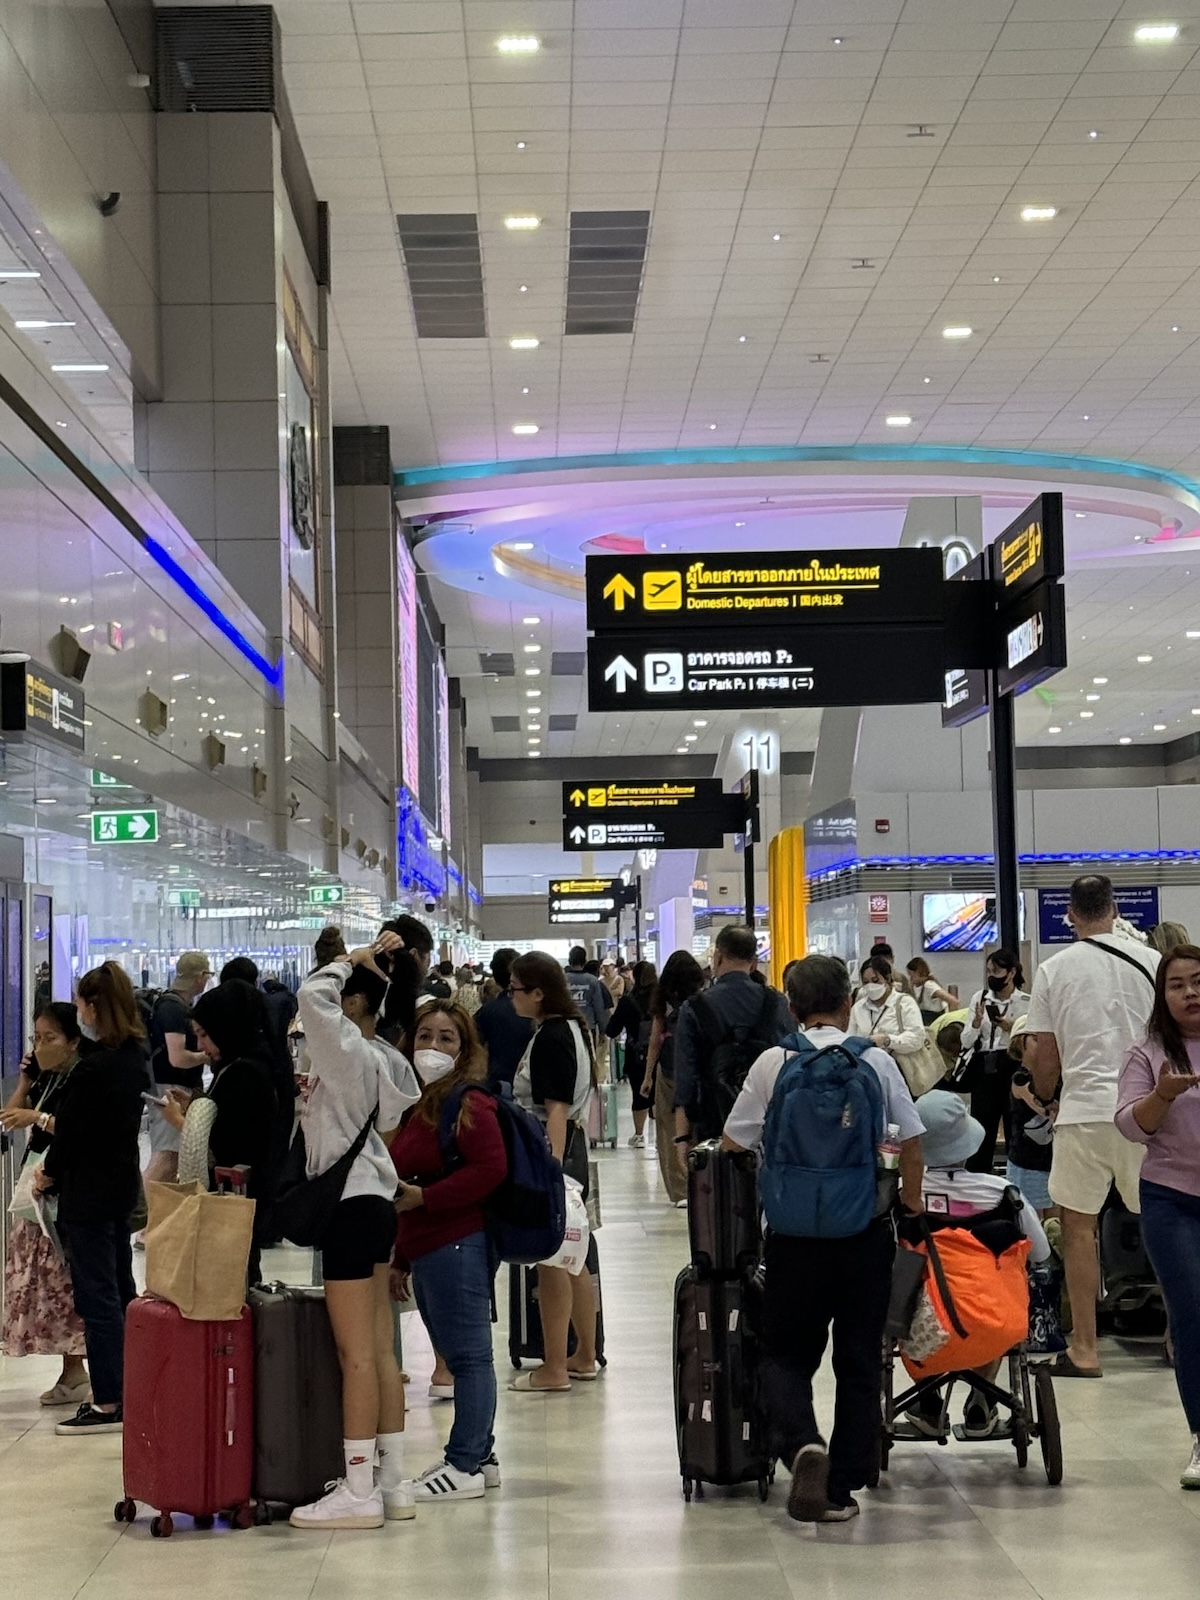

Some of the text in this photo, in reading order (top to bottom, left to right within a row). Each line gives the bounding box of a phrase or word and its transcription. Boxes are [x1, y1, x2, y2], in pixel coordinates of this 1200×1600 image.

[686, 559, 880, 590] ผู้โดยสารขาออกภายในประเทศ
[686, 595, 789, 611] Domestic Departures
[687, 651, 771, 667] อาคารจอดรถ
[688, 678, 707, 691] Car
[708, 677, 733, 691] Park
[741, 734, 772, 771] 11
